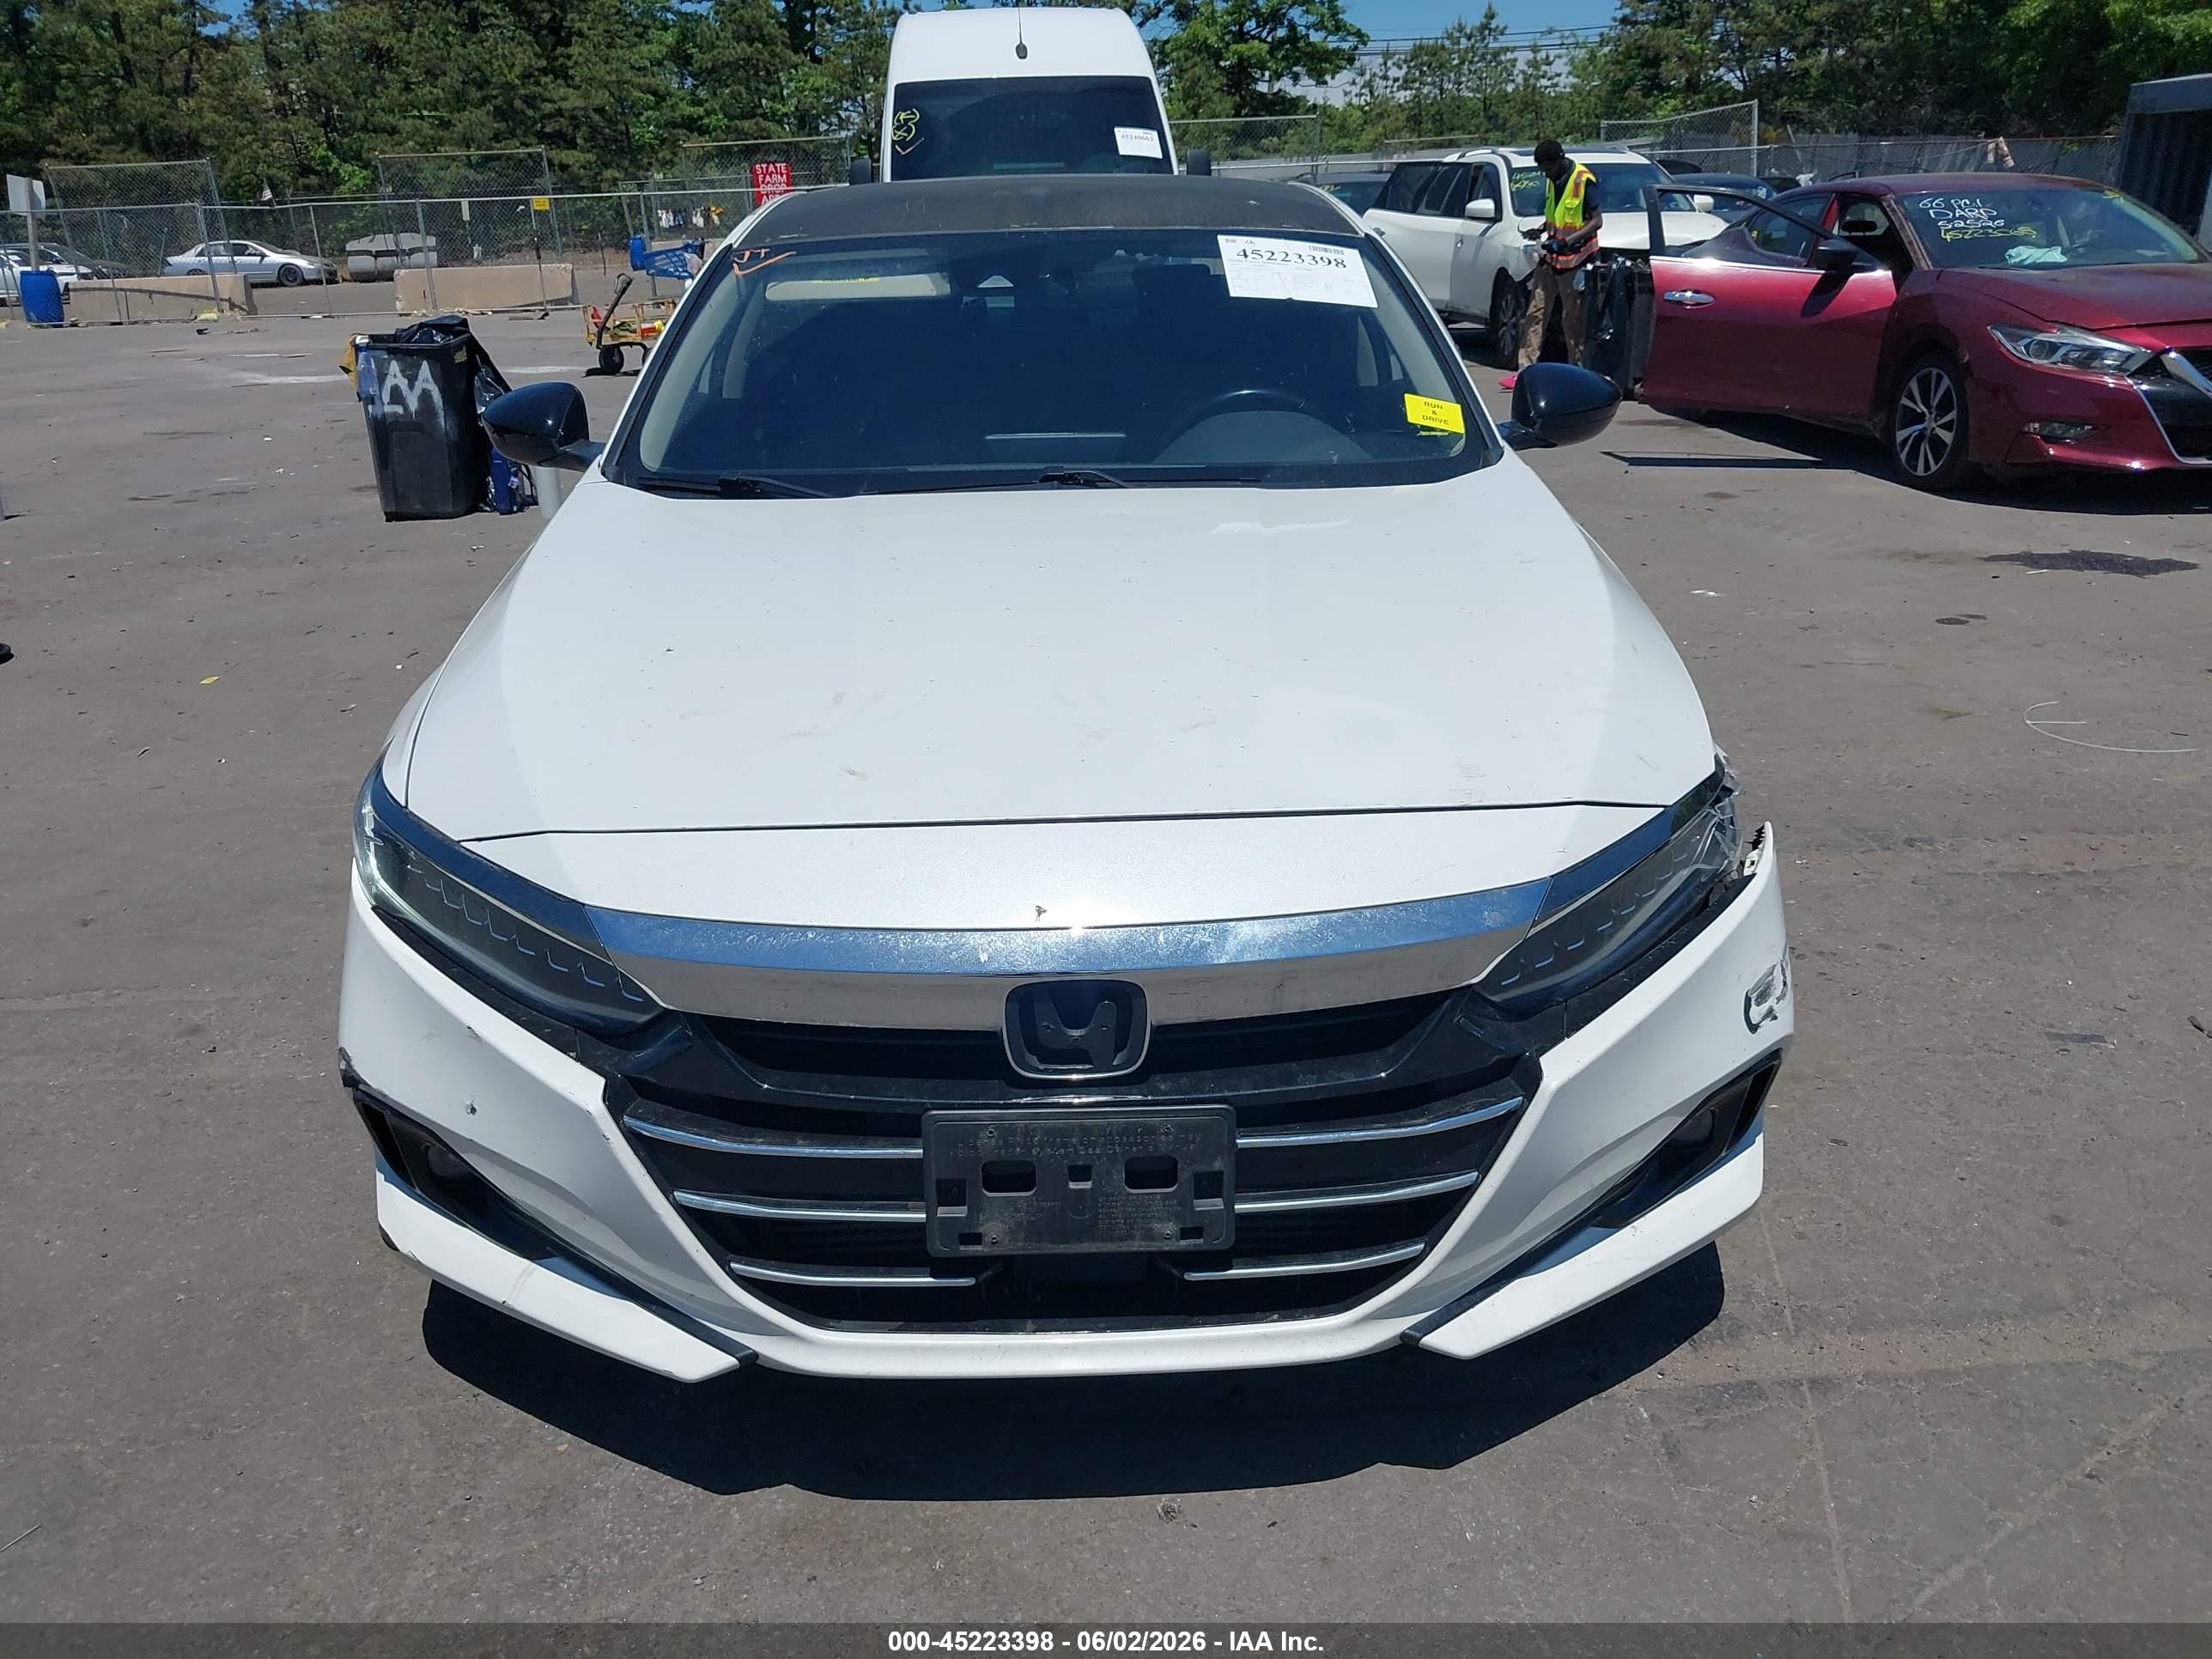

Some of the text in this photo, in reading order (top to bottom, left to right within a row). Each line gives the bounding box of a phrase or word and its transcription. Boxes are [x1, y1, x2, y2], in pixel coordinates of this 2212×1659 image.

[756, 162, 787, 174] STATE
[758, 173, 787, 184] FARM
[1918, 198, 1945, 208] 66
[1236, 247, 1347, 269] 45223398
[1424, 401, 1443, 410] RUN
[1421, 415, 1449, 425] DRIVE
